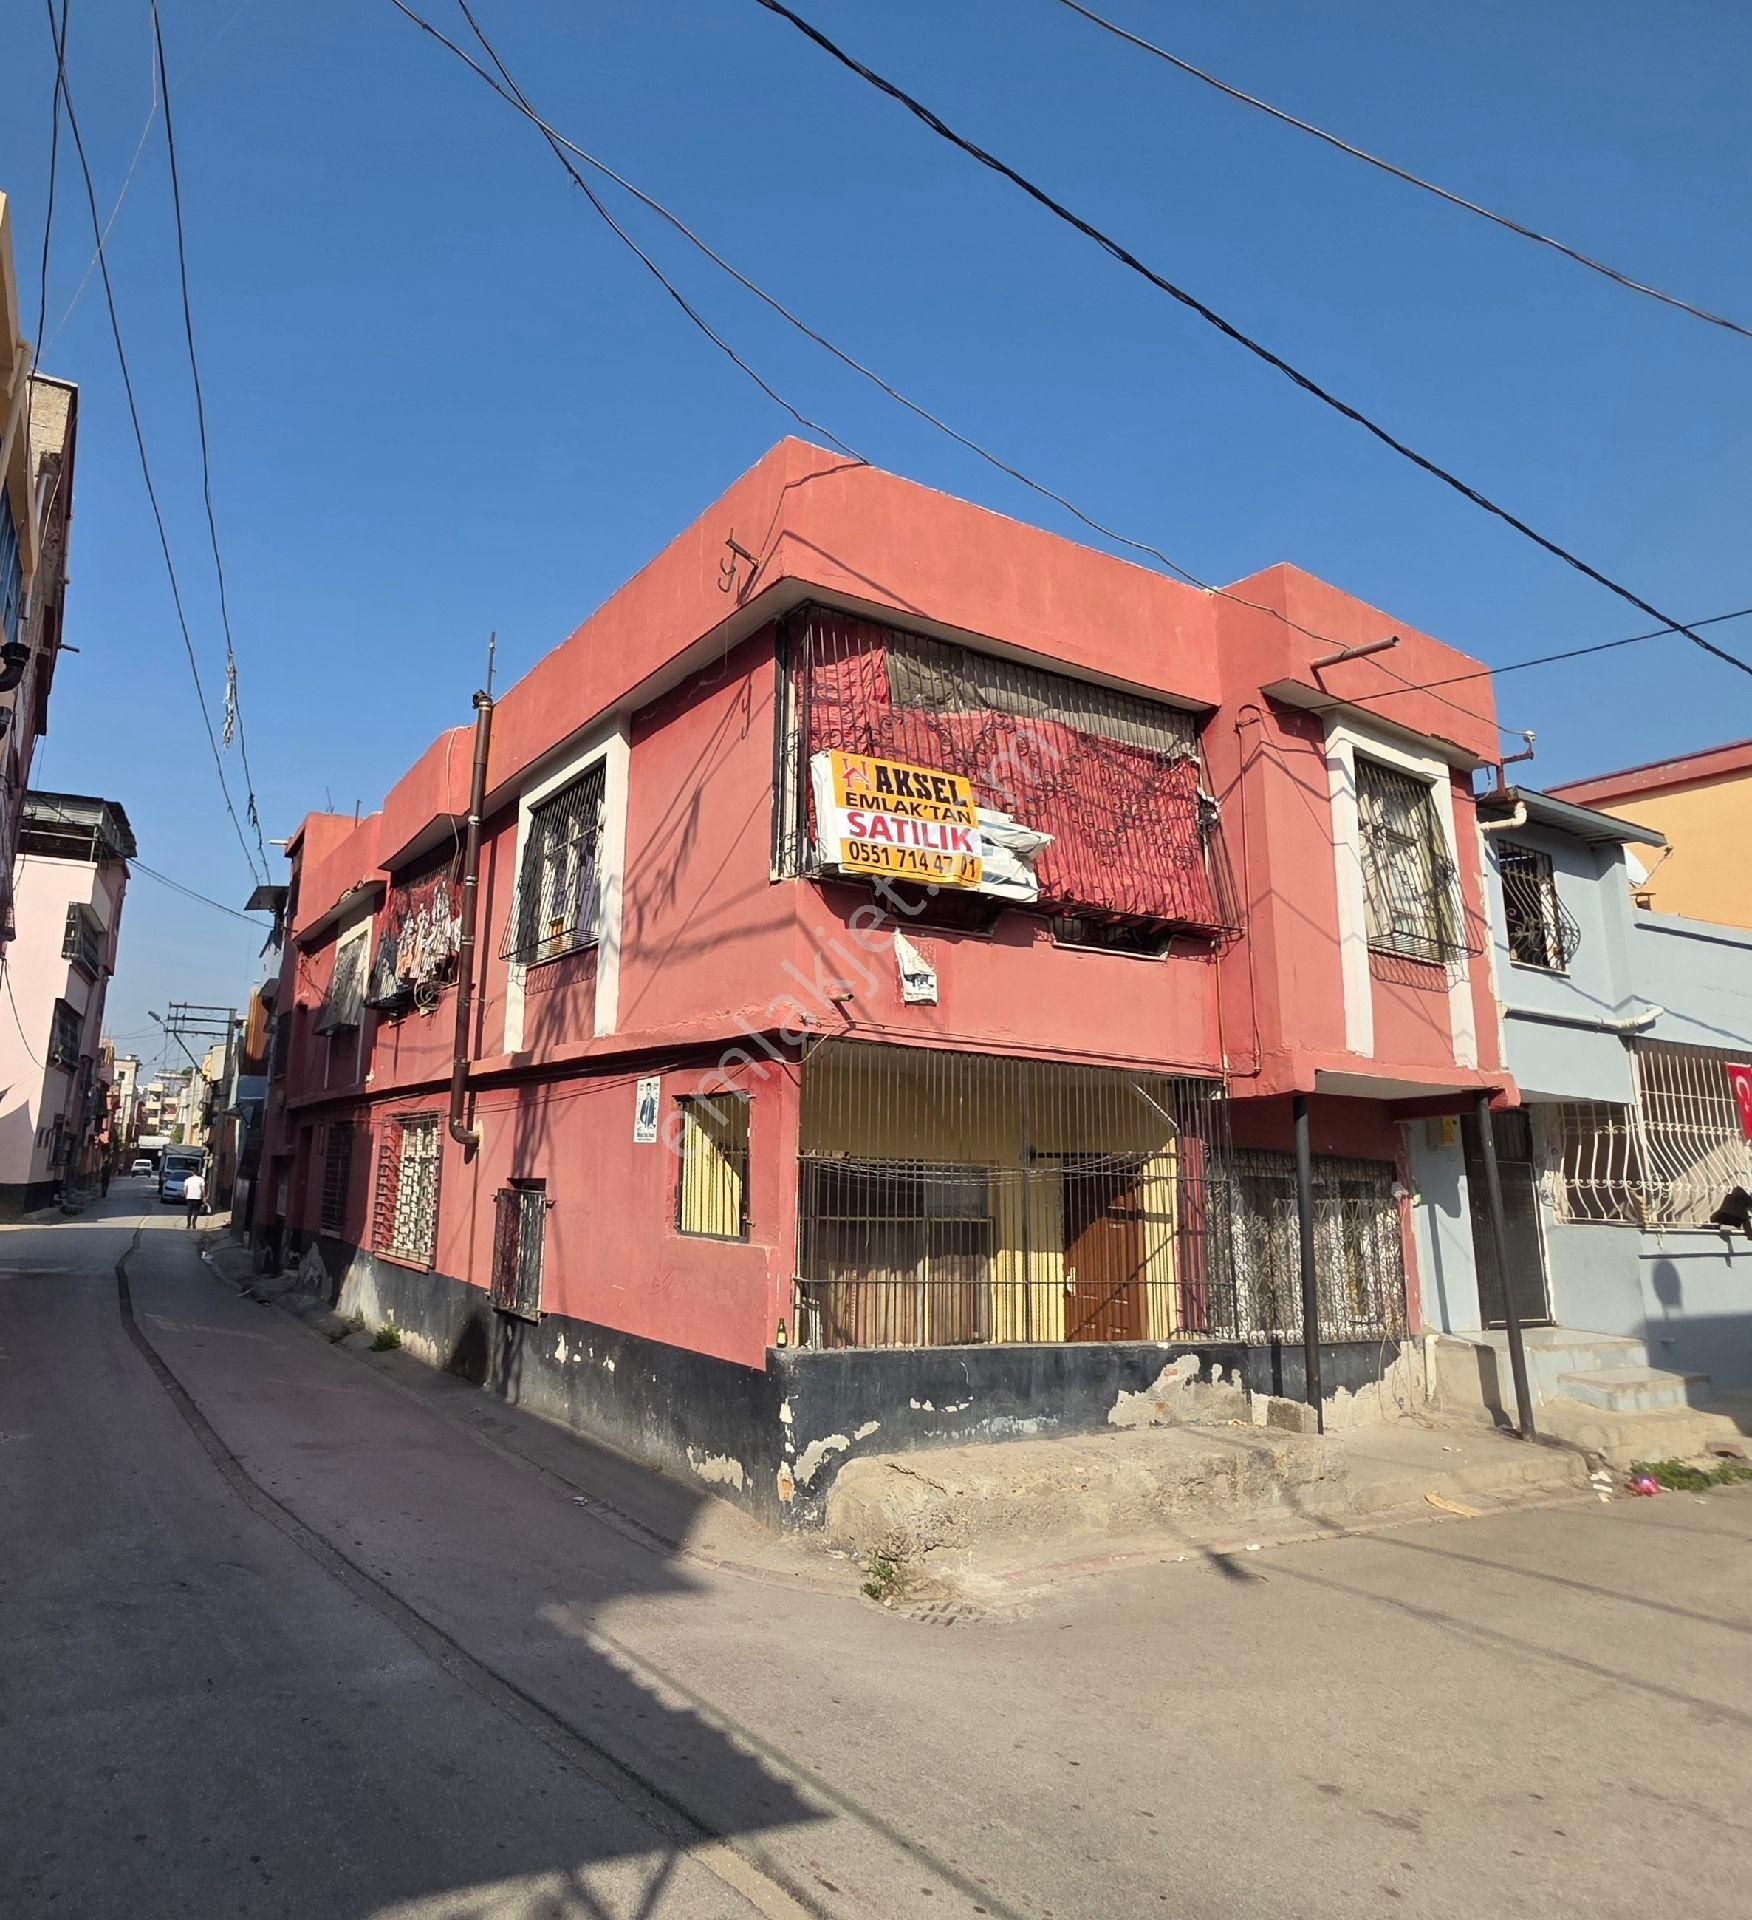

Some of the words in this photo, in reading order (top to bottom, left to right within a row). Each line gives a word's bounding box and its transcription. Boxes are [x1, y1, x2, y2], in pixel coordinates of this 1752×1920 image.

[875, 765, 968, 807] AKSEL
[845, 792, 972, 824] EMLAK'TAN
[847, 812, 973, 853] SATILIK
[850, 841, 890, 865] 0551
[897, 849, 928, 871] 714
[934, 854, 953, 874] 47
